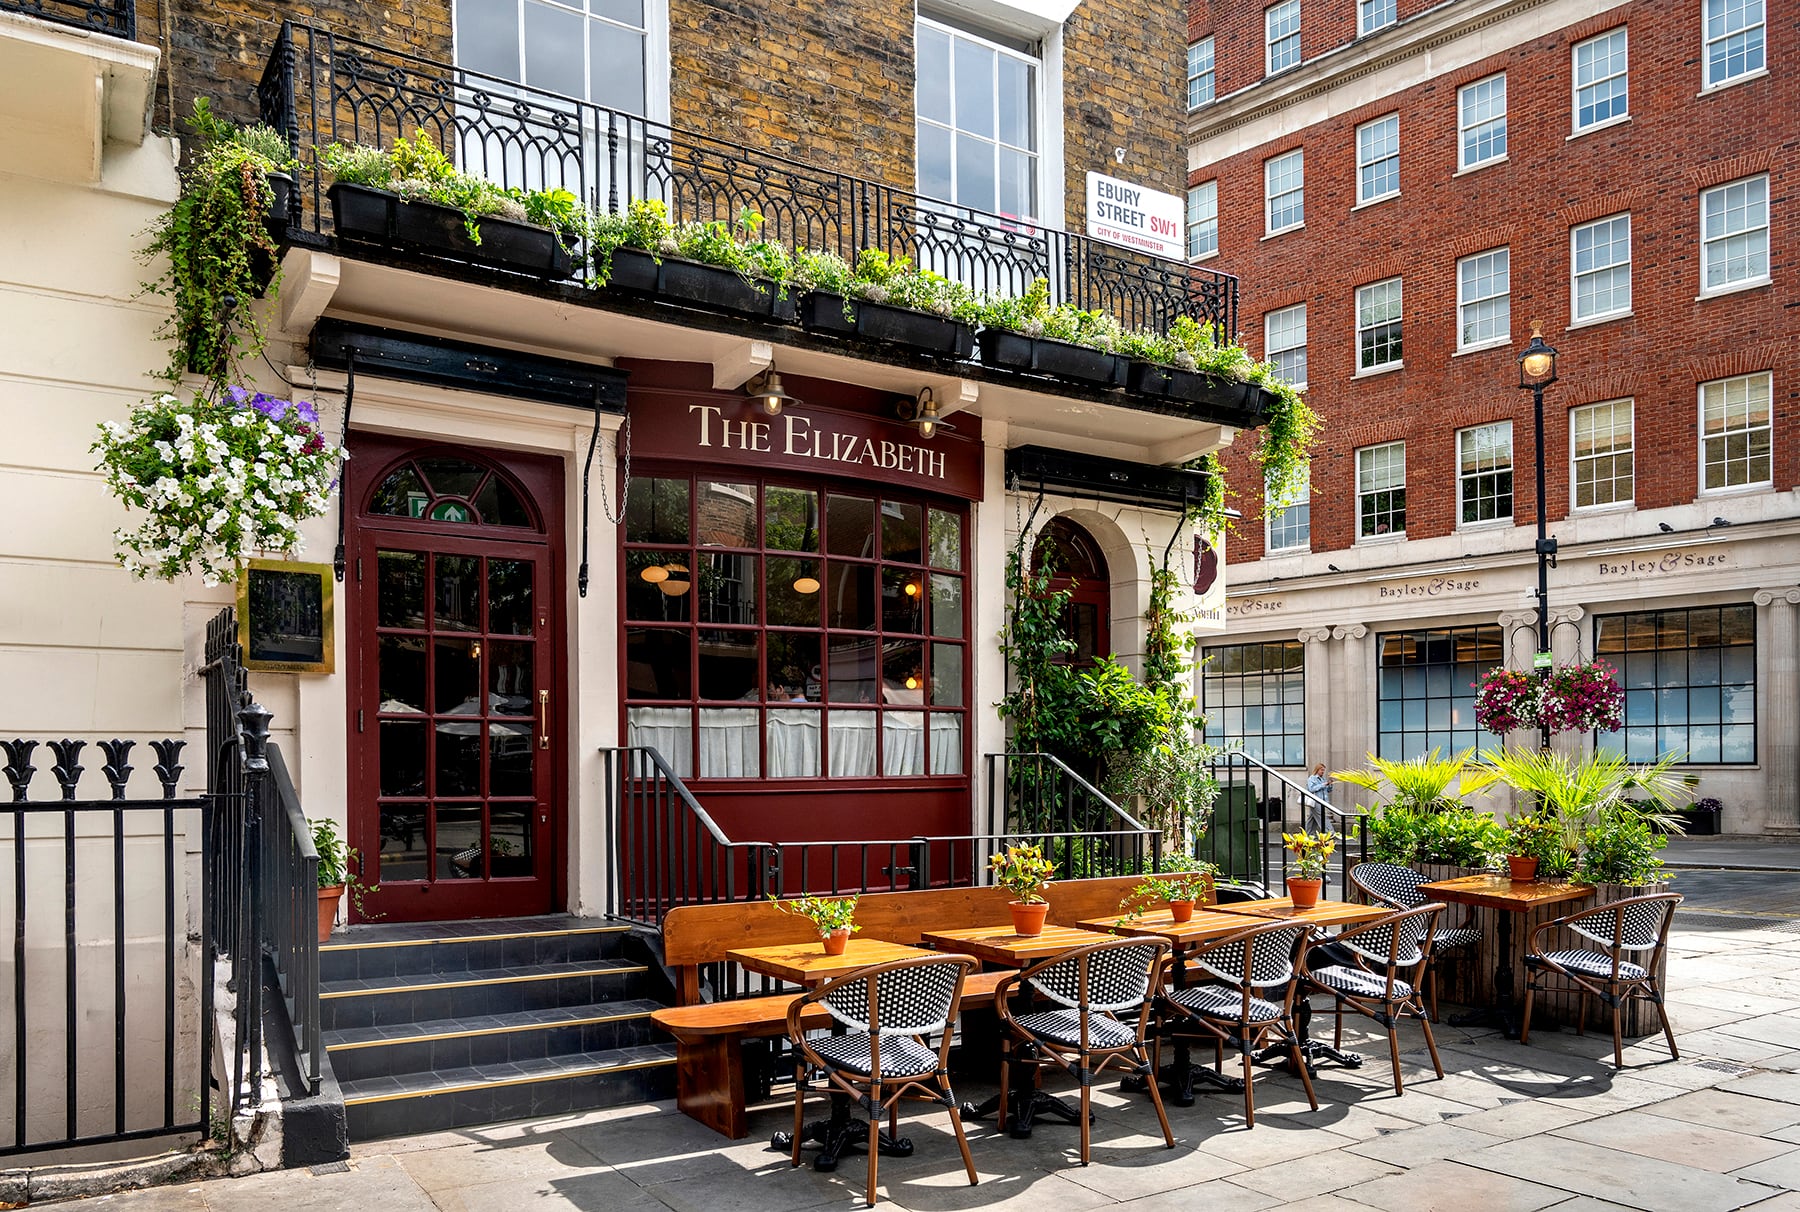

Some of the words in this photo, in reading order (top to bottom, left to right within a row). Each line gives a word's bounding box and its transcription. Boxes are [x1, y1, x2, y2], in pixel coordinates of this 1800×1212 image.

[1097, 180, 1141, 208] EBURY
[1096, 201, 1146, 228] STREET
[1150, 216, 1177, 238] SW1
[1097, 227, 1112, 238] CITY
[1112, 231, 1121, 240] OF
[1122, 234, 1164, 252] WESTMINSTER
[689, 404, 771, 452] THE
[783, 414, 945, 479] ELIZABETH
[1599, 560, 1656, 575] Bayley
[1659, 552, 1682, 572] &
[1684, 553, 1726, 567] Sage
[1380, 584, 1425, 598] Bayley
[1427, 578, 1445, 596] &
[1446, 579, 1480, 591] Sage
[1256, 600, 1282, 611] Sage
